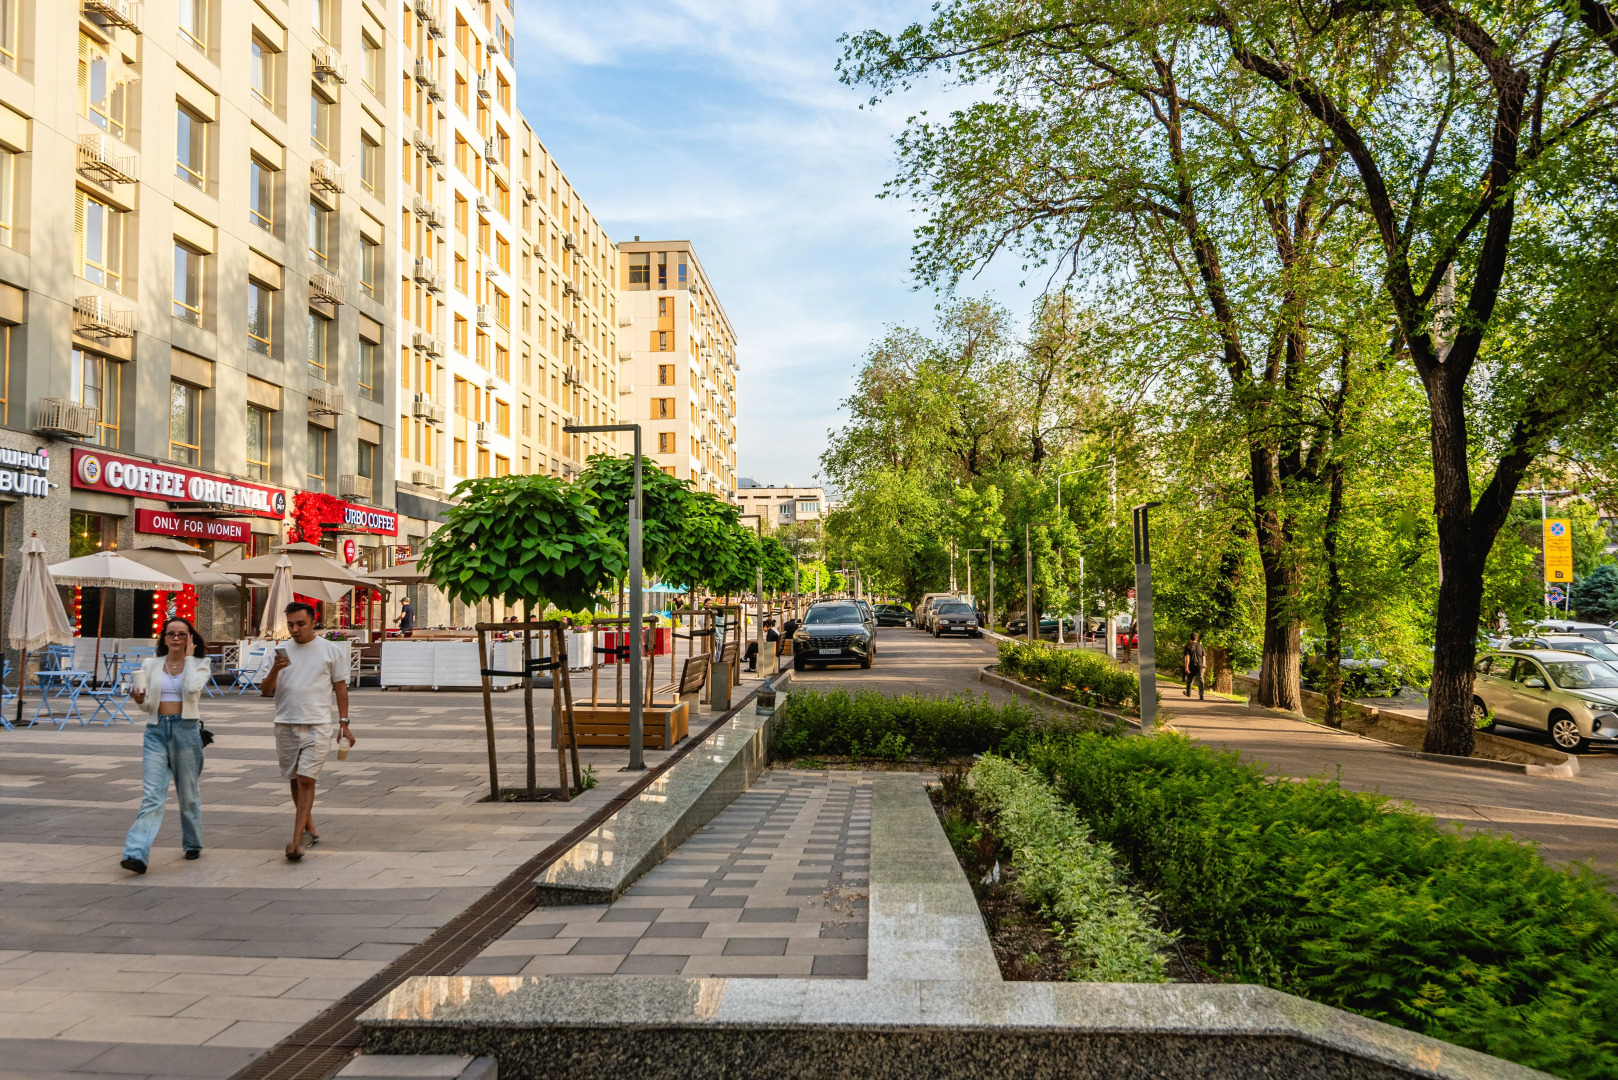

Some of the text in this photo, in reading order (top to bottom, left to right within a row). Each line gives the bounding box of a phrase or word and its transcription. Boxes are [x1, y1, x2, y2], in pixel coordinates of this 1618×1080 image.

[105, 461, 271, 512] COFFEE ORIGINAL
[153, 515, 242, 537] ONLY FOR WOMEN
[368, 512, 395, 531] COFFEE
